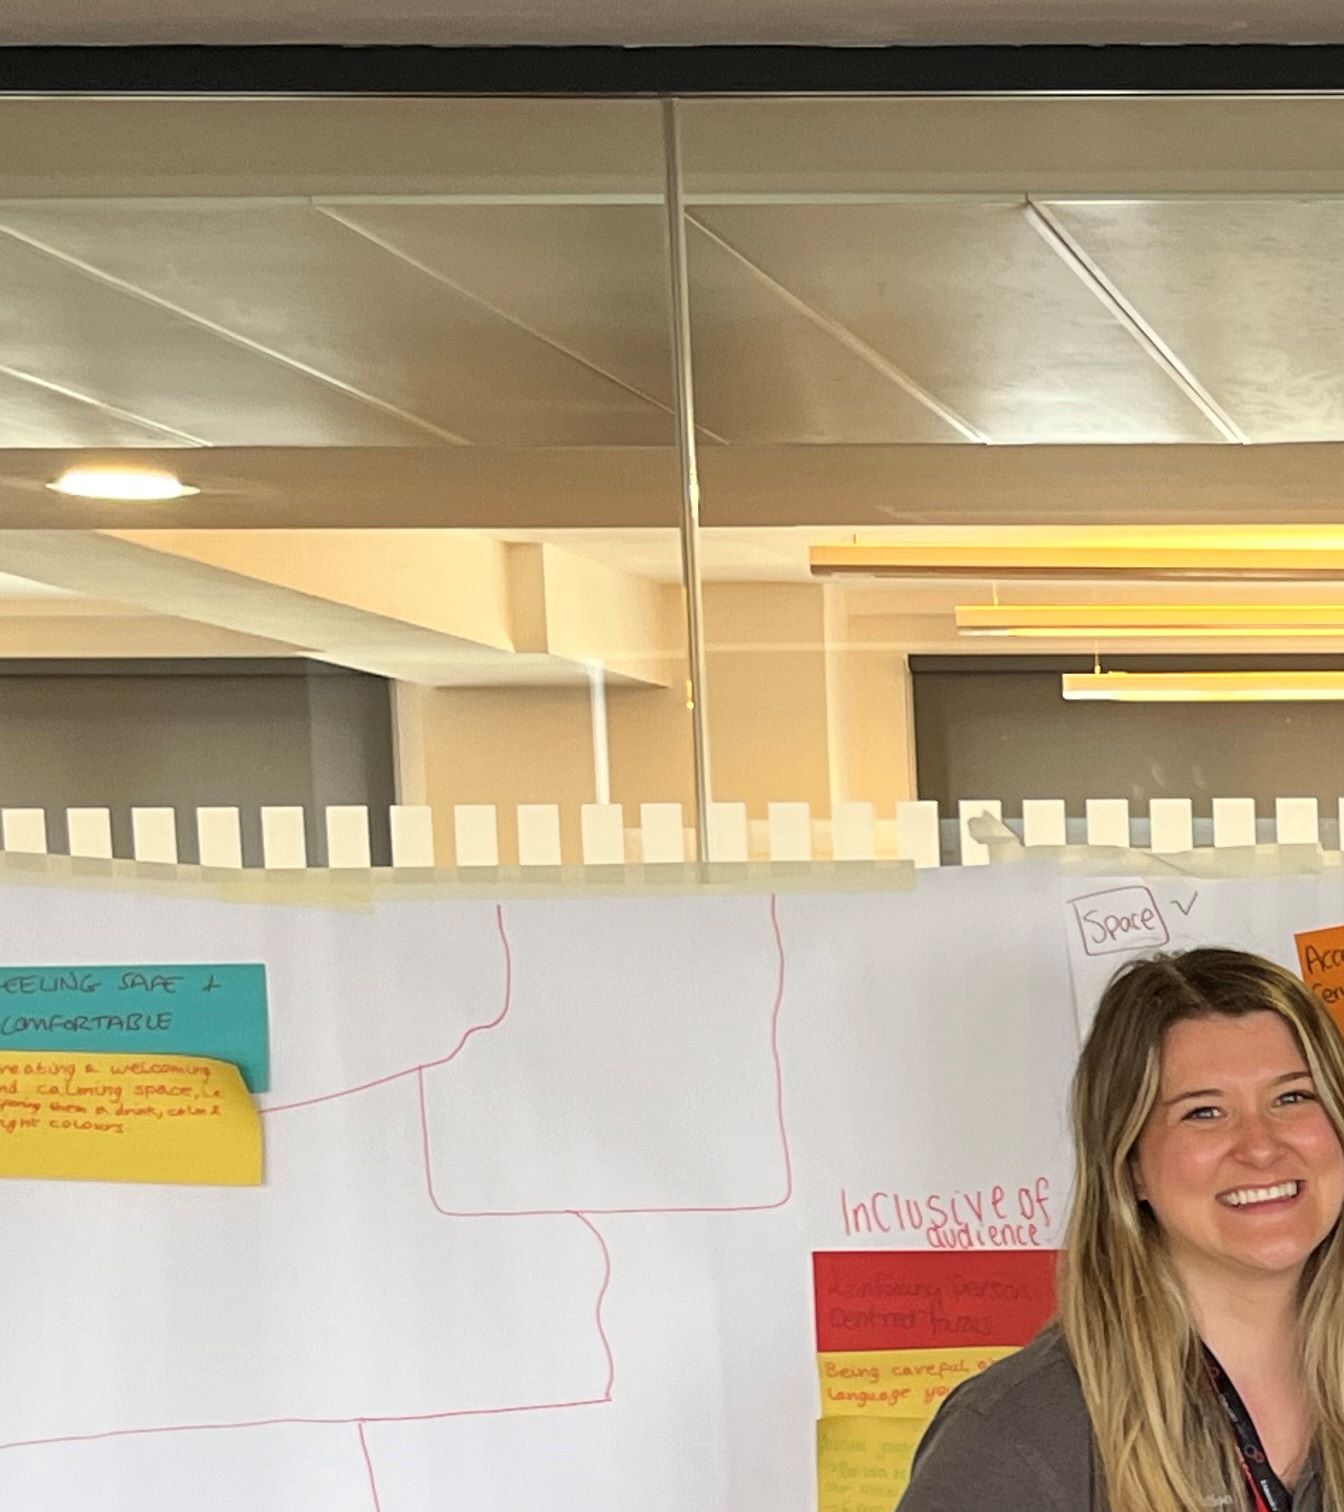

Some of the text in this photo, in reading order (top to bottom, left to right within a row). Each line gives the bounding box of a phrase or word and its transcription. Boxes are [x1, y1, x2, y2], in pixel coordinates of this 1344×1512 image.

[1083, 908, 1155, 943] Space
[0, 972, 102, 994] EELING
[117, 972, 183, 994] SAFE
[0, 1011, 173, 1036] COMFORTABLE
[0, 1060, 76, 1083] reating
[110, 1062, 211, 1083] welcoming
[840, 1176, 1051, 1236] Inclusive of
[926, 1223, 1042, 1249] audience
[826, 1361, 969, 1385] Being careful
[826, 1386, 911, 1407] language
